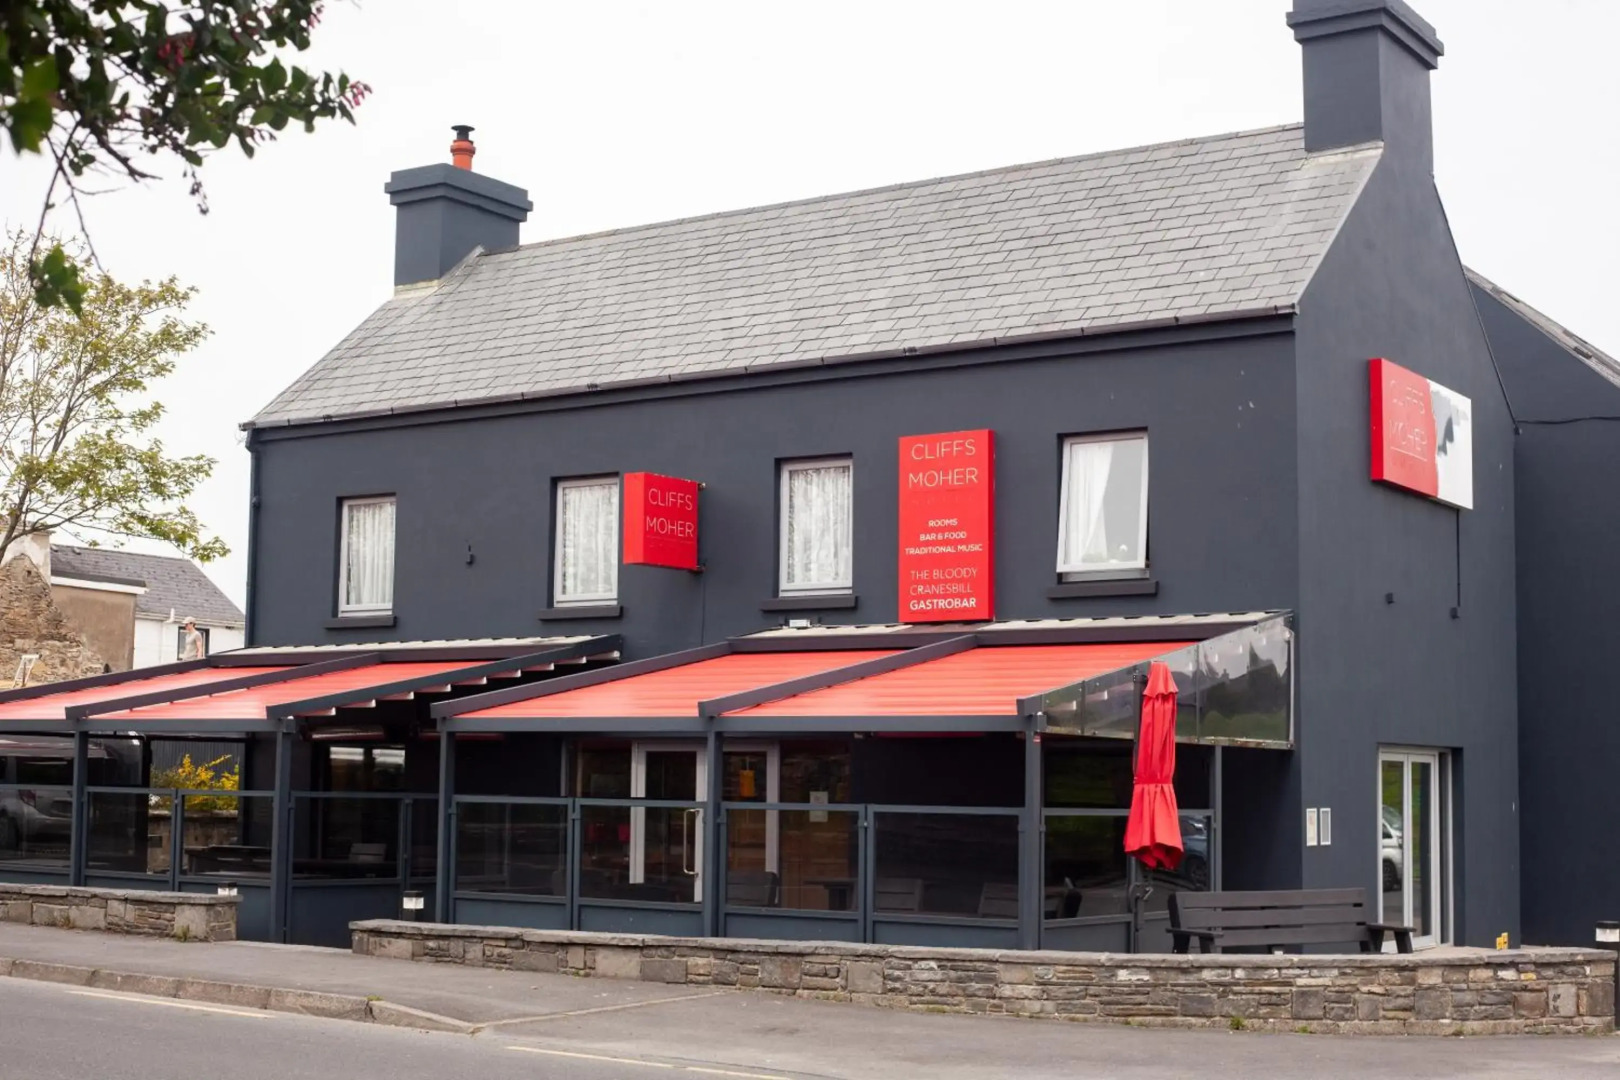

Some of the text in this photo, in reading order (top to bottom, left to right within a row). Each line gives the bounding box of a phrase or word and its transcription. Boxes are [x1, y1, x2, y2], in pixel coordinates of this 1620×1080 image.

[911, 439, 976, 460] CLIFFS
[908, 467, 978, 488] MOHER
[648, 488, 693, 511] CLIFFS
[646, 515, 694, 537] MOHER
[928, 518, 958, 527] ROOMS
[919, 532, 937, 542] BAR
[944, 531, 967, 540] FOOD
[905, 543, 983, 555] TRADITIONAL MUSIC
[910, 567, 978, 580] THE BLOODY
[909, 582, 973, 596] CRANESBILL
[909, 597, 977, 611] GASTROBAR
